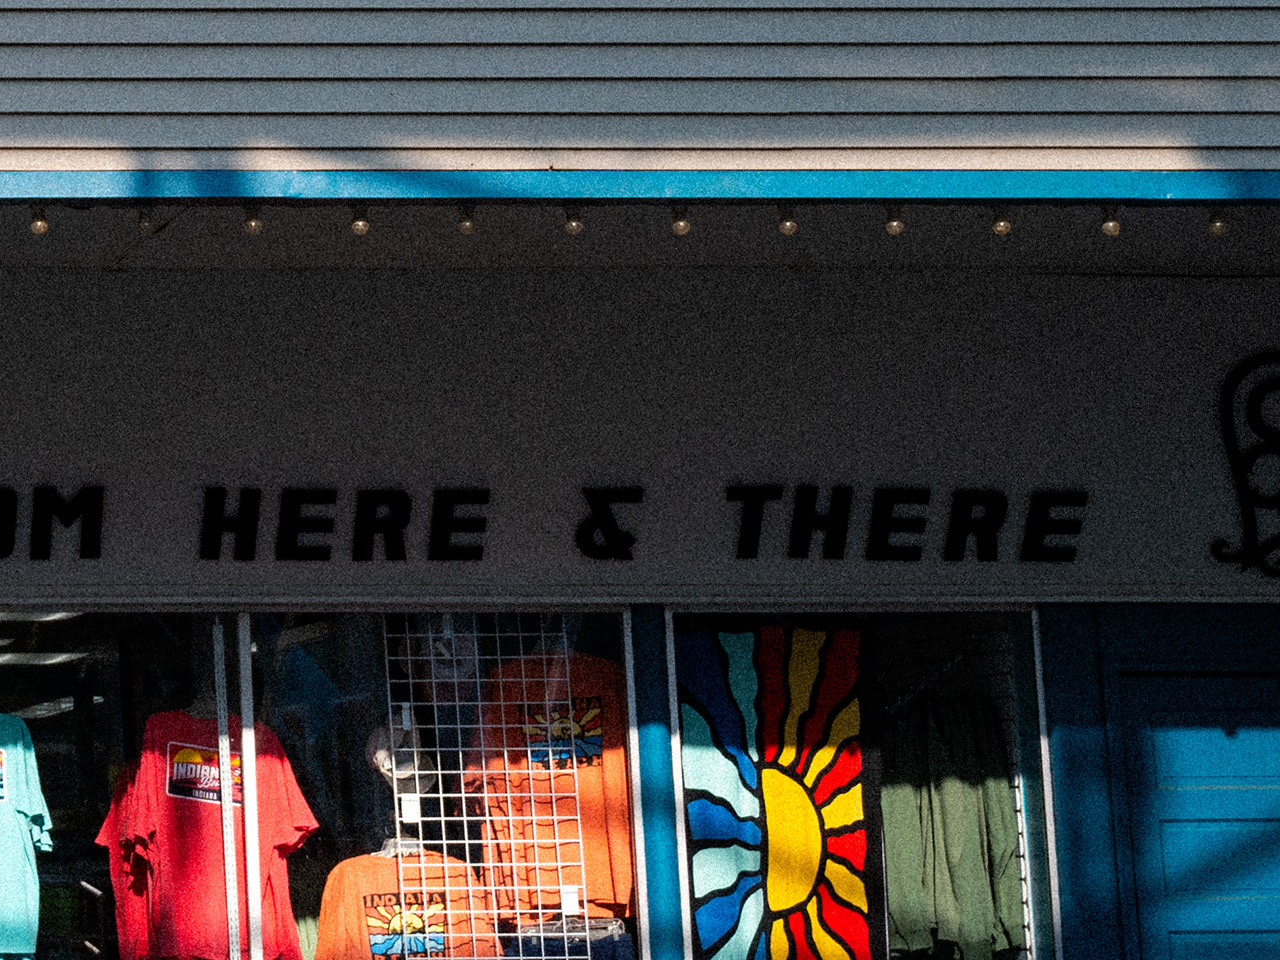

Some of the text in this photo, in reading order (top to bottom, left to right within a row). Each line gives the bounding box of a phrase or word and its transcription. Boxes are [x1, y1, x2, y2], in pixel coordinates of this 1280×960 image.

[198, 486, 490, 562] HERE
[574, 487, 645, 562] &
[726, 485, 1090, 562] THERE
[173, 762, 220, 780] INDIAN
[365, 892, 442, 908] INDANA
